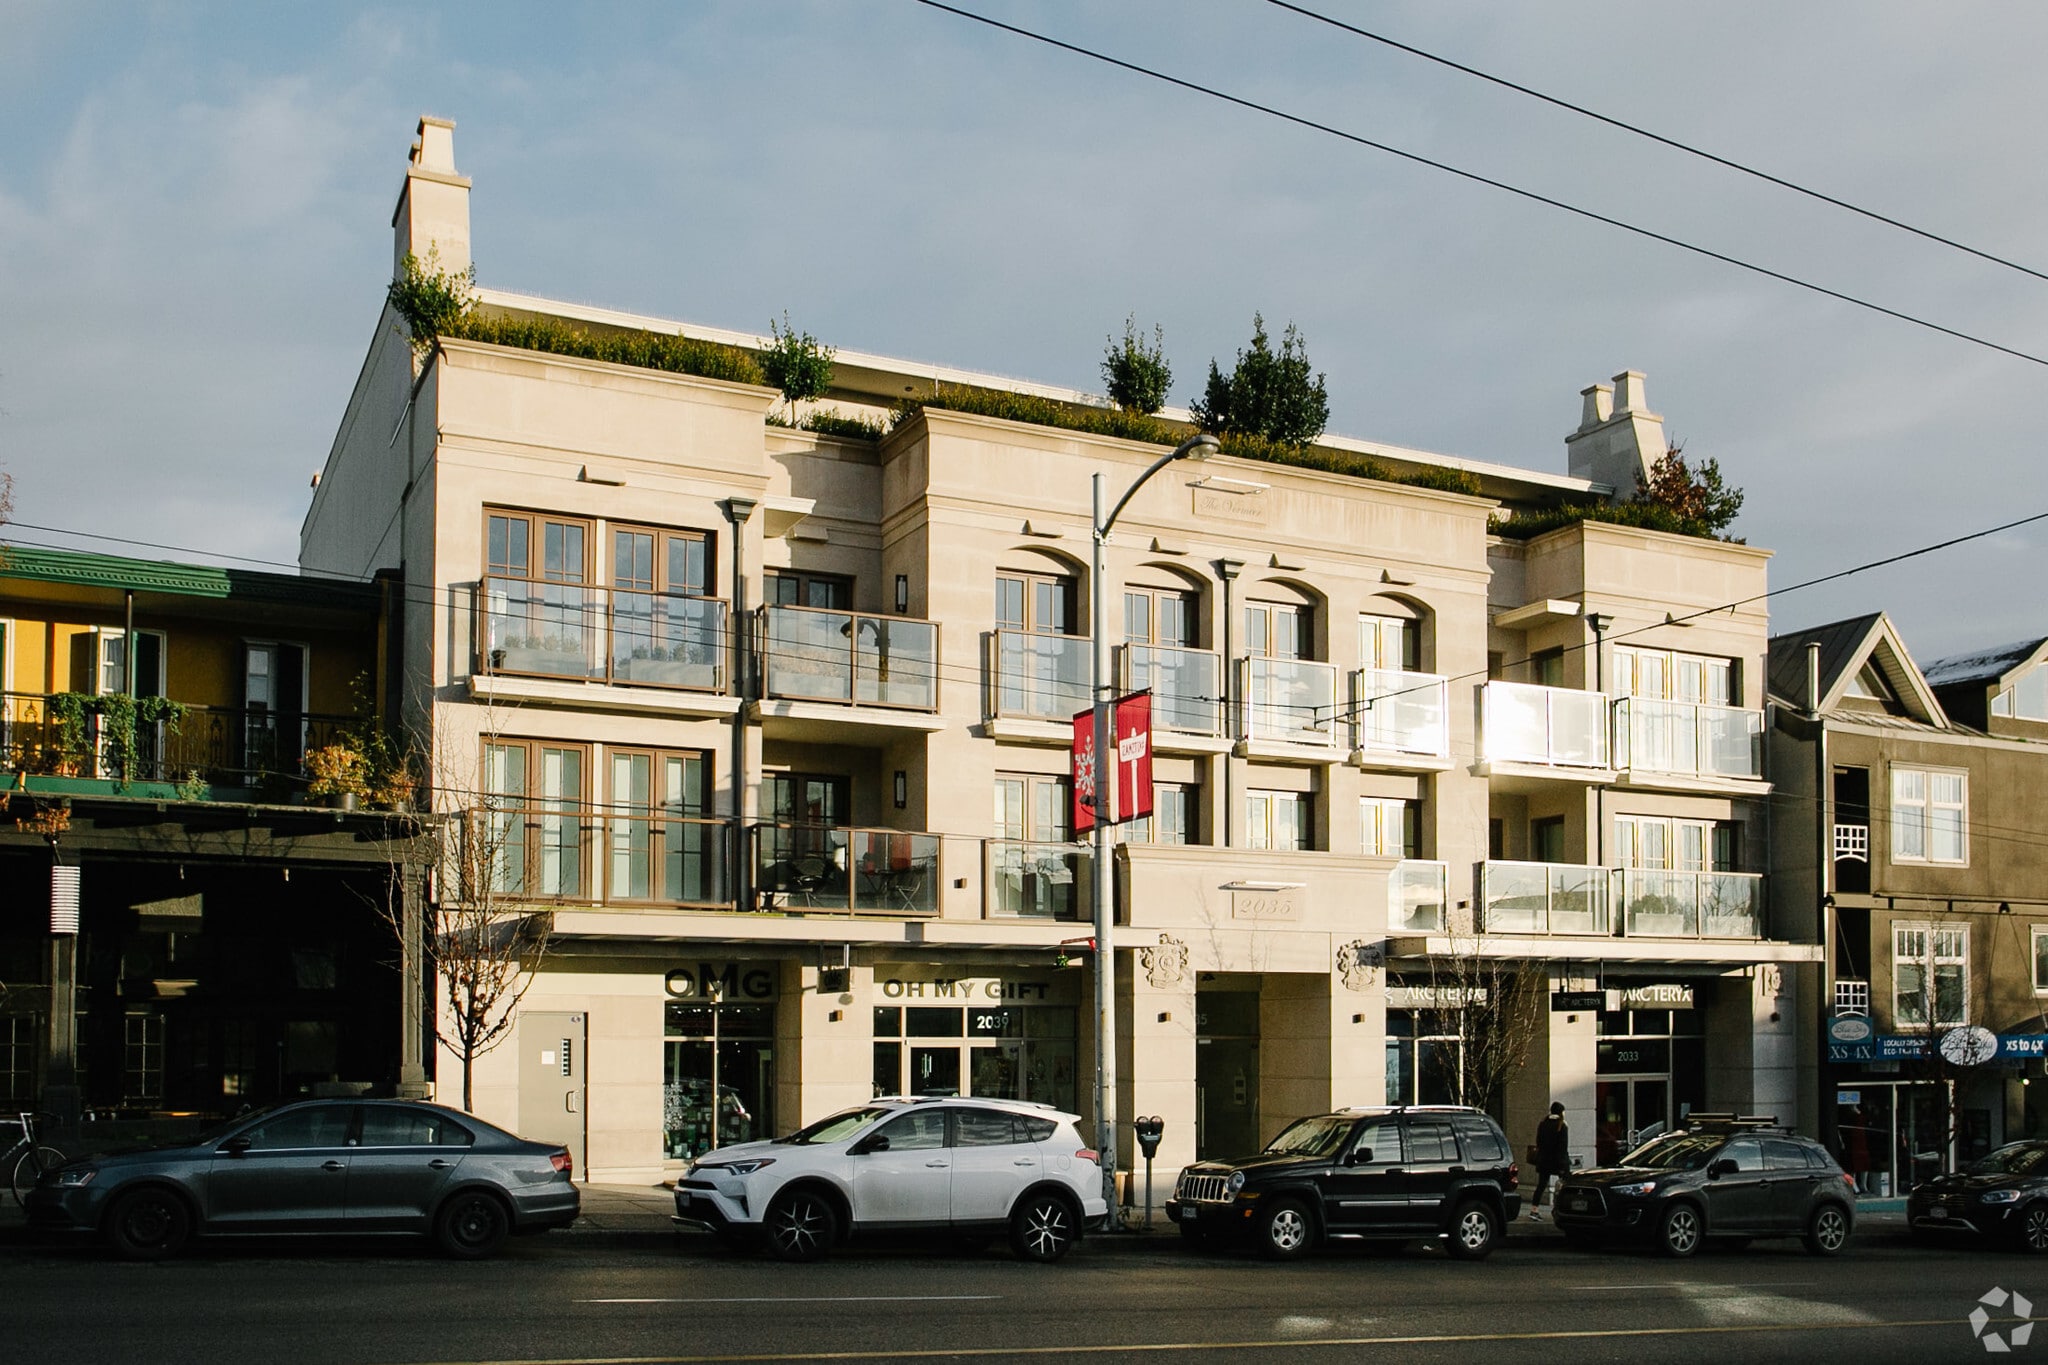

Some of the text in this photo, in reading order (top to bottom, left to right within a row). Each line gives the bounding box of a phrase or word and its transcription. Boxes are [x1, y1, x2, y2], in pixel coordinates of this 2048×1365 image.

[1240, 899, 1292, 914] 2035
[665, 963, 773, 998] OMG
[883, 979, 1050, 999] OH MY GIFT
[977, 1015, 1009, 1029] 2039
[2006, 1040, 2018, 1051] XS
[2019, 1038, 2030, 1051] to
[2031, 1040, 2044, 1054] 4X
[1617, 1051, 1639, 1062] 2033
